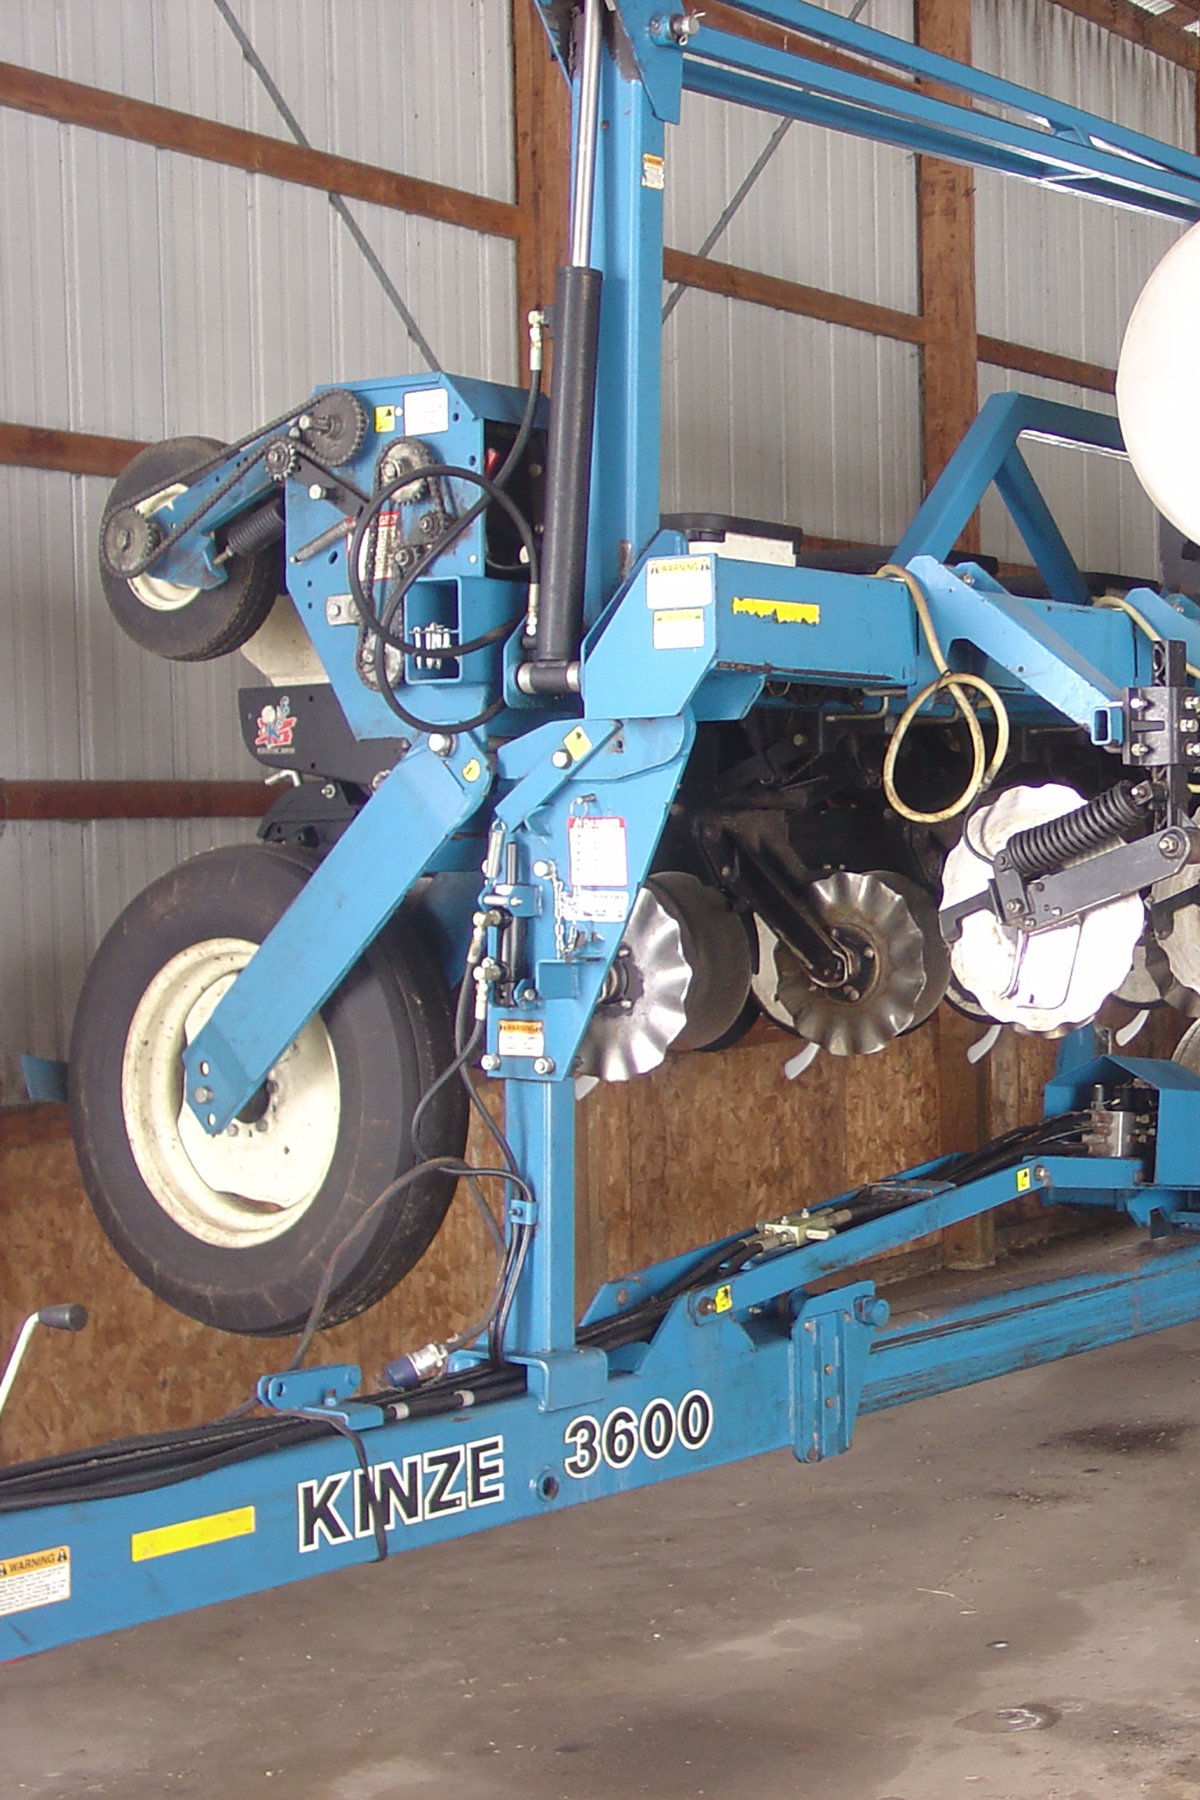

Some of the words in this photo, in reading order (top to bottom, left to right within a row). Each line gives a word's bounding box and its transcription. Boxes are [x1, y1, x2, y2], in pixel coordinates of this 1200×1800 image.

[297, 1435, 504, 1553] KINZE
[564, 1389, 714, 1479] 3600
[8, 1553, 56, 1573] WARNING
